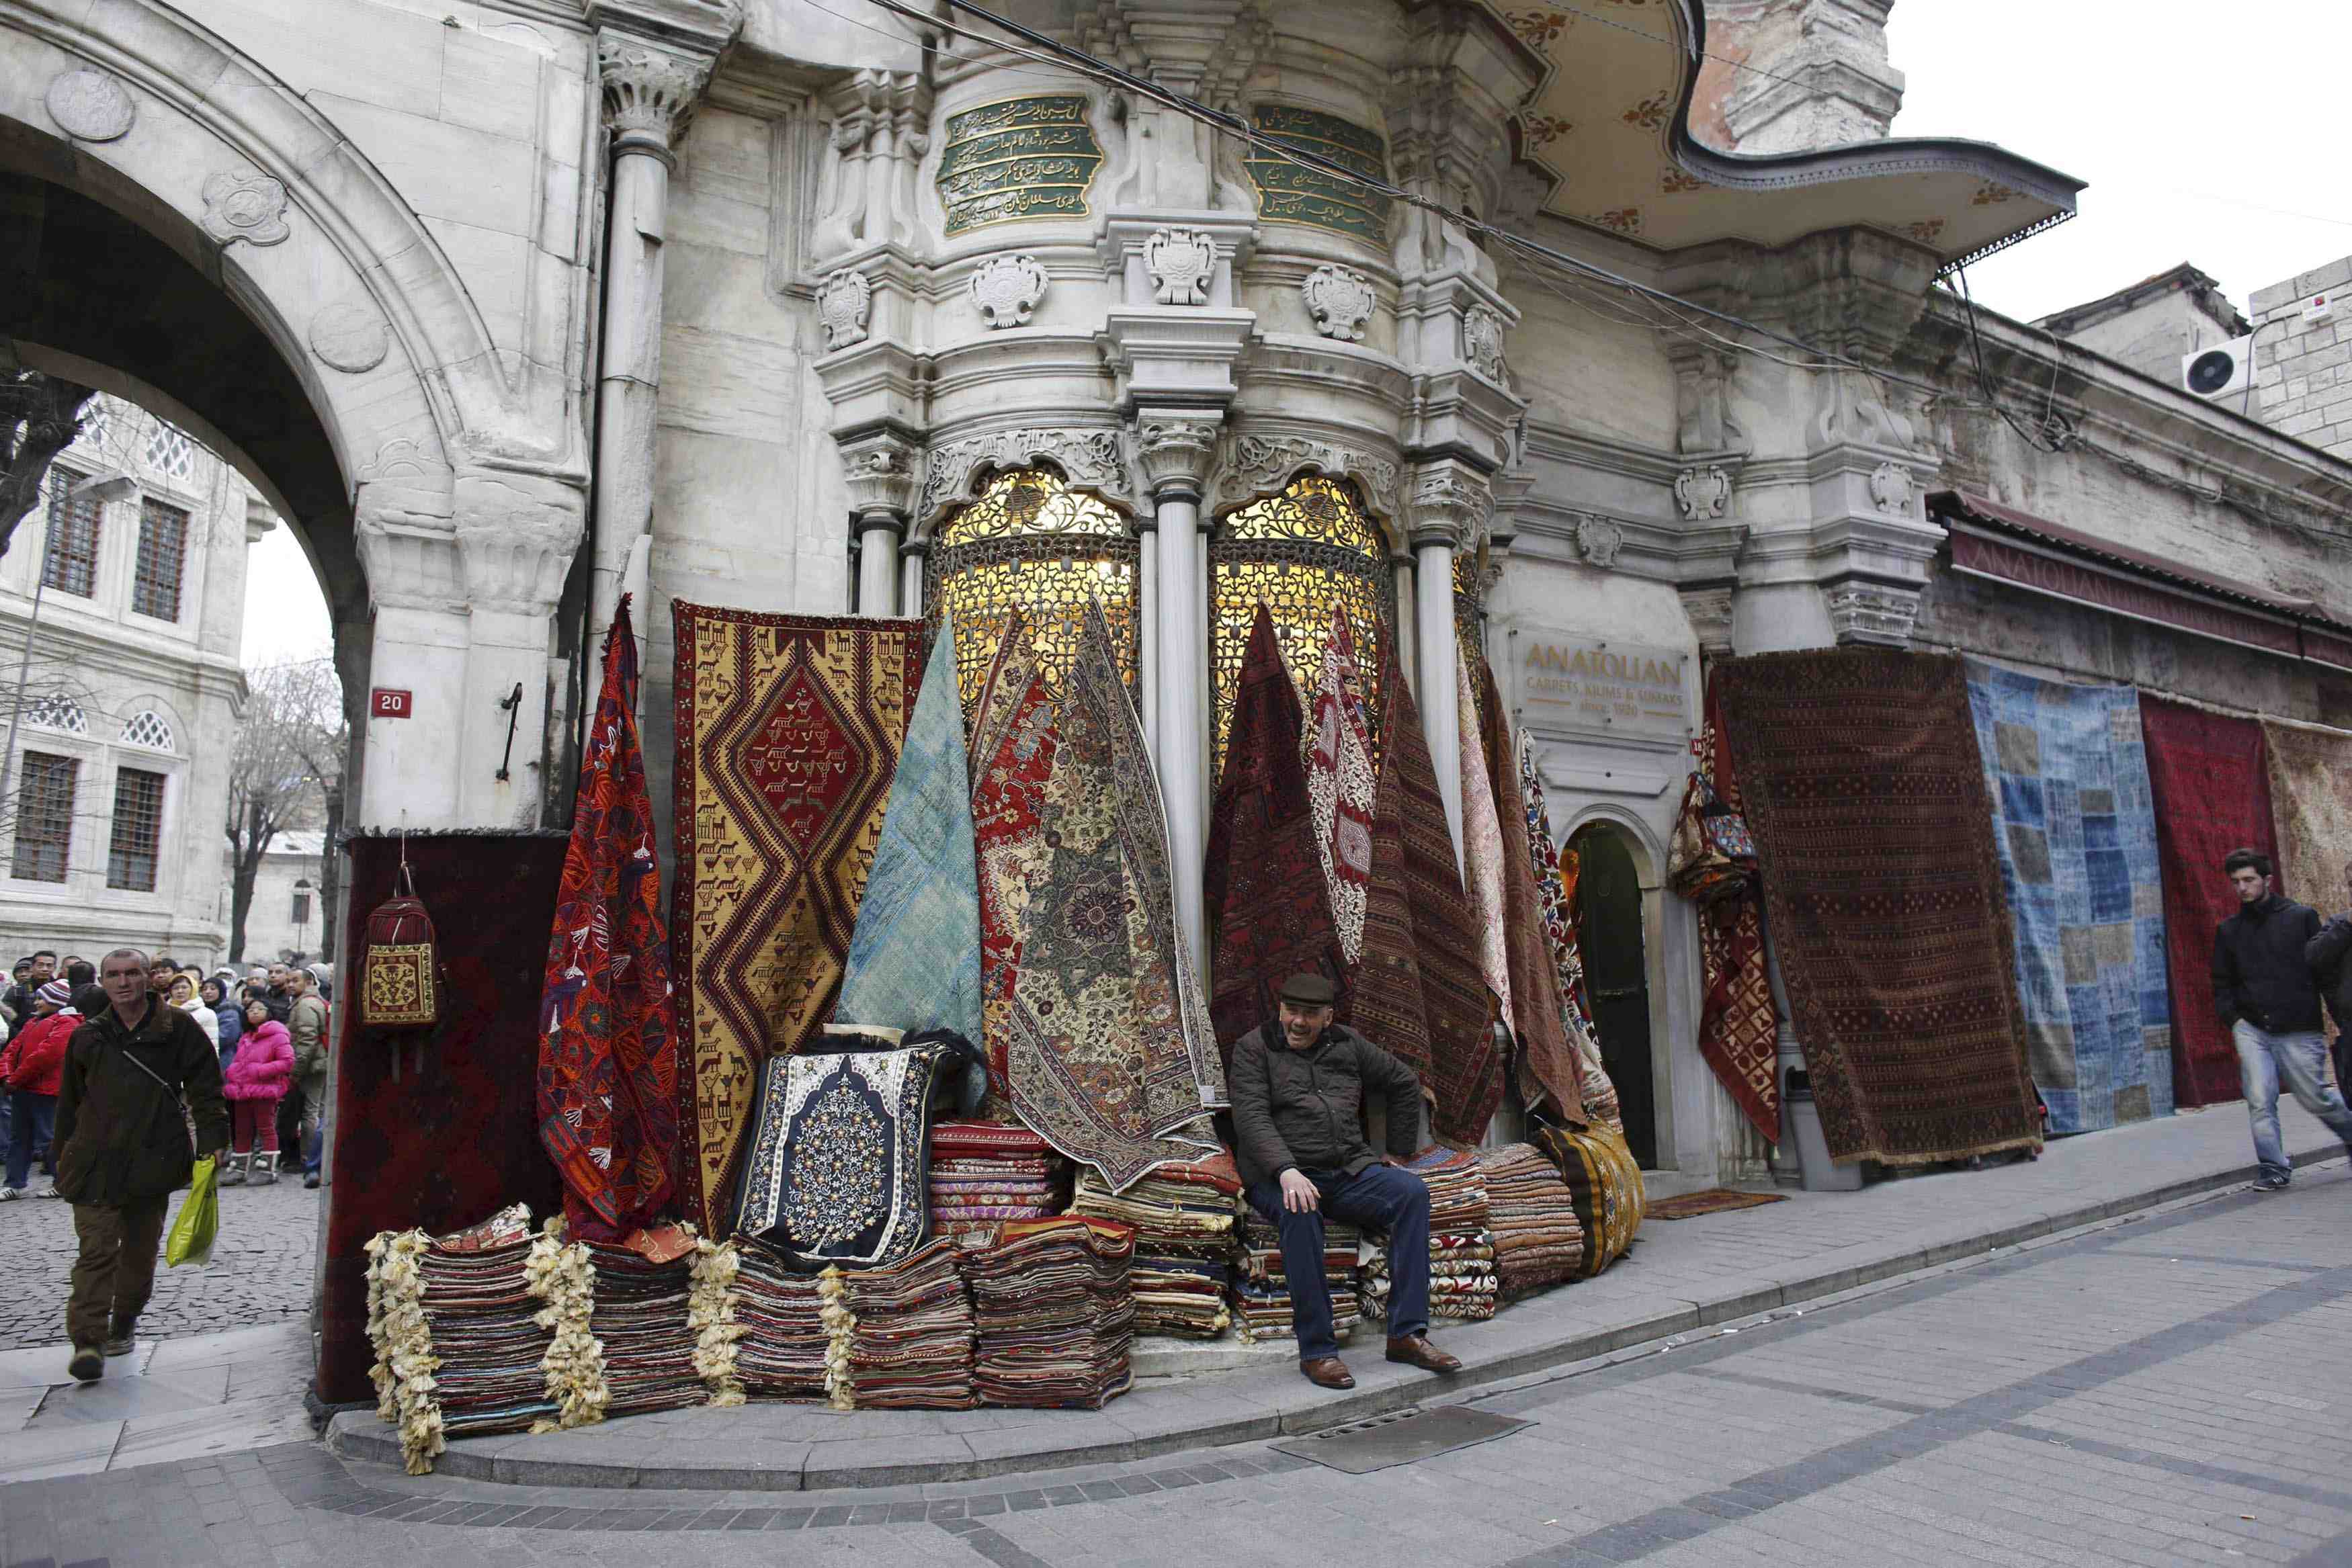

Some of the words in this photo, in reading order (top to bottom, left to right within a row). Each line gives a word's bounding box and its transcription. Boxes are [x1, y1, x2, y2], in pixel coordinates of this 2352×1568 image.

[1526, 643, 1681, 686] ANATOLIAN
[381, 695, 402, 710] 20
[1693, 741, 1702, 752] 18
